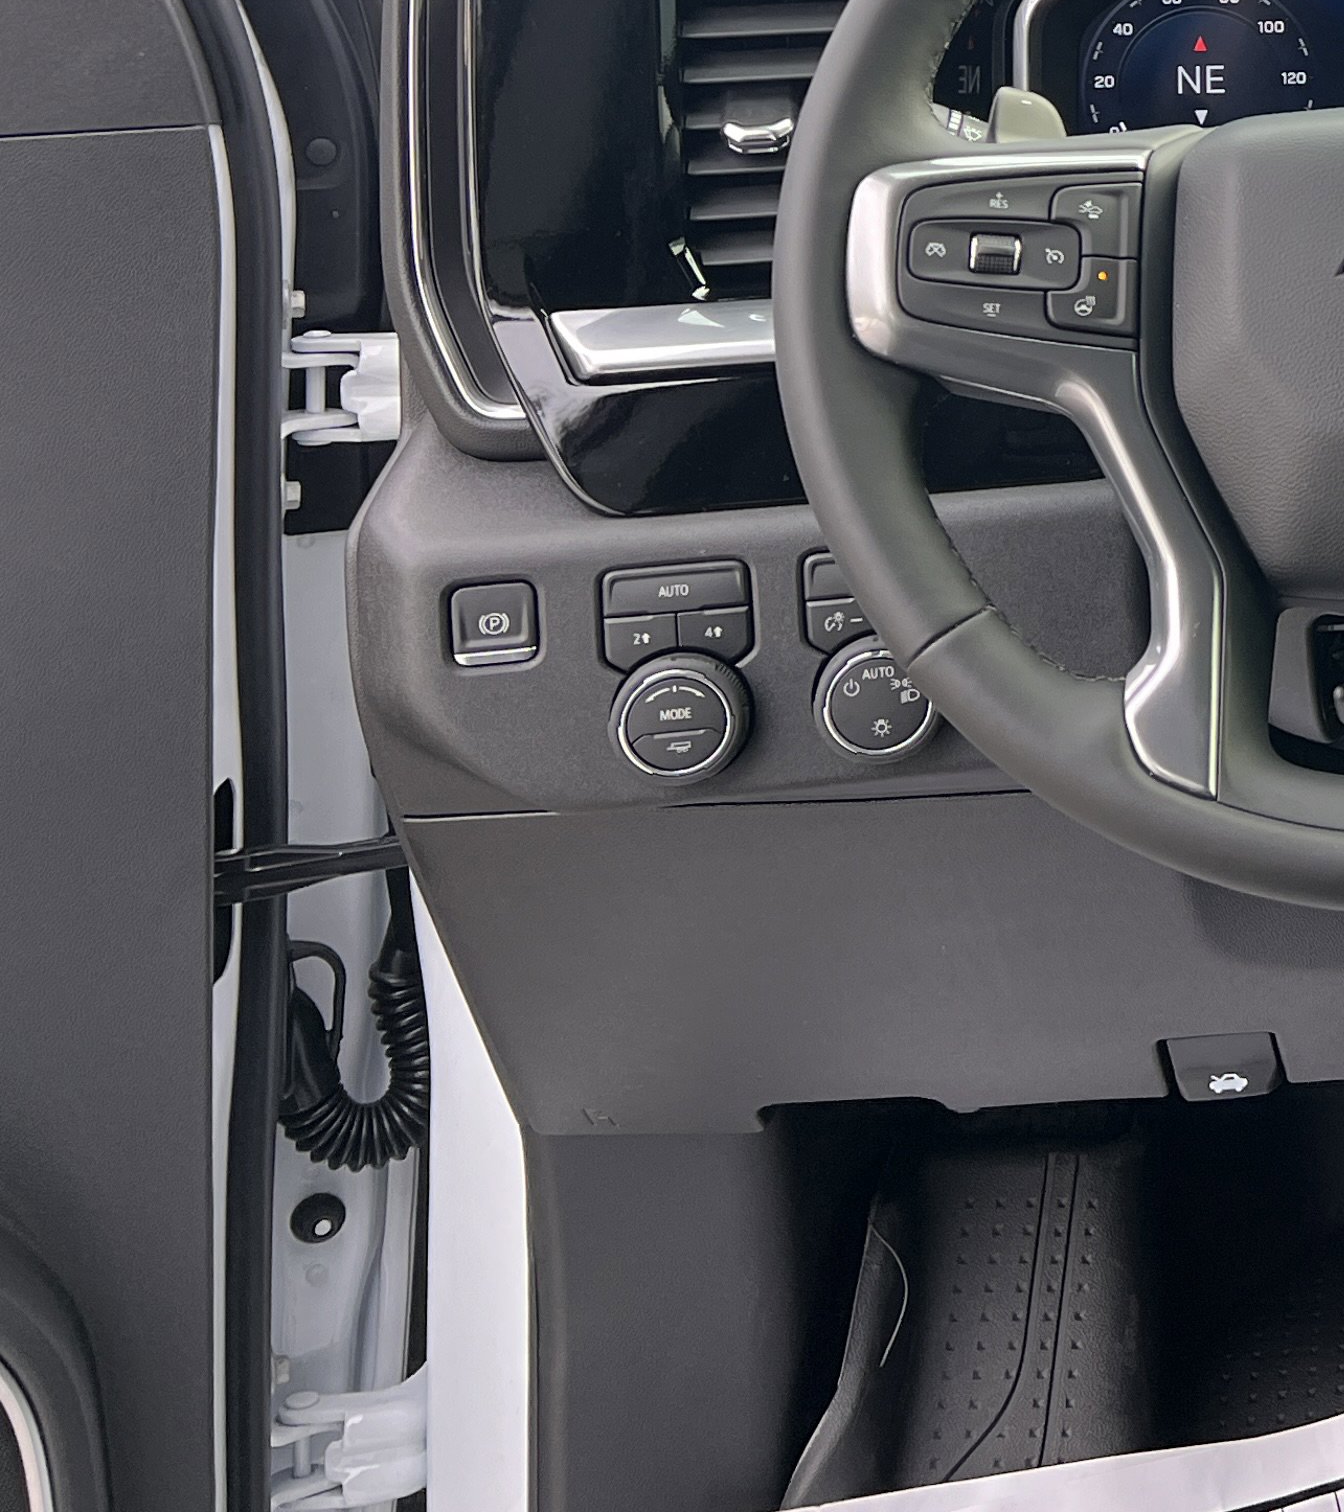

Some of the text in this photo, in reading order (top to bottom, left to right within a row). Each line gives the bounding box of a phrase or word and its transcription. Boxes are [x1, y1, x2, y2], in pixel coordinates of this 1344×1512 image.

[1112, 23, 1134, 36] 40
[1257, 20, 1285, 34] 100
[1094, 75, 1115, 89] 20
[1177, 64, 1226, 95] NE
[1281, 71, 1307, 85] 120
[982, 302, 1001, 314] SET
[658, 583, 690, 598] AUTO
[862, 666, 895, 681] AUTO
[659, 707, 692, 721] MODE
